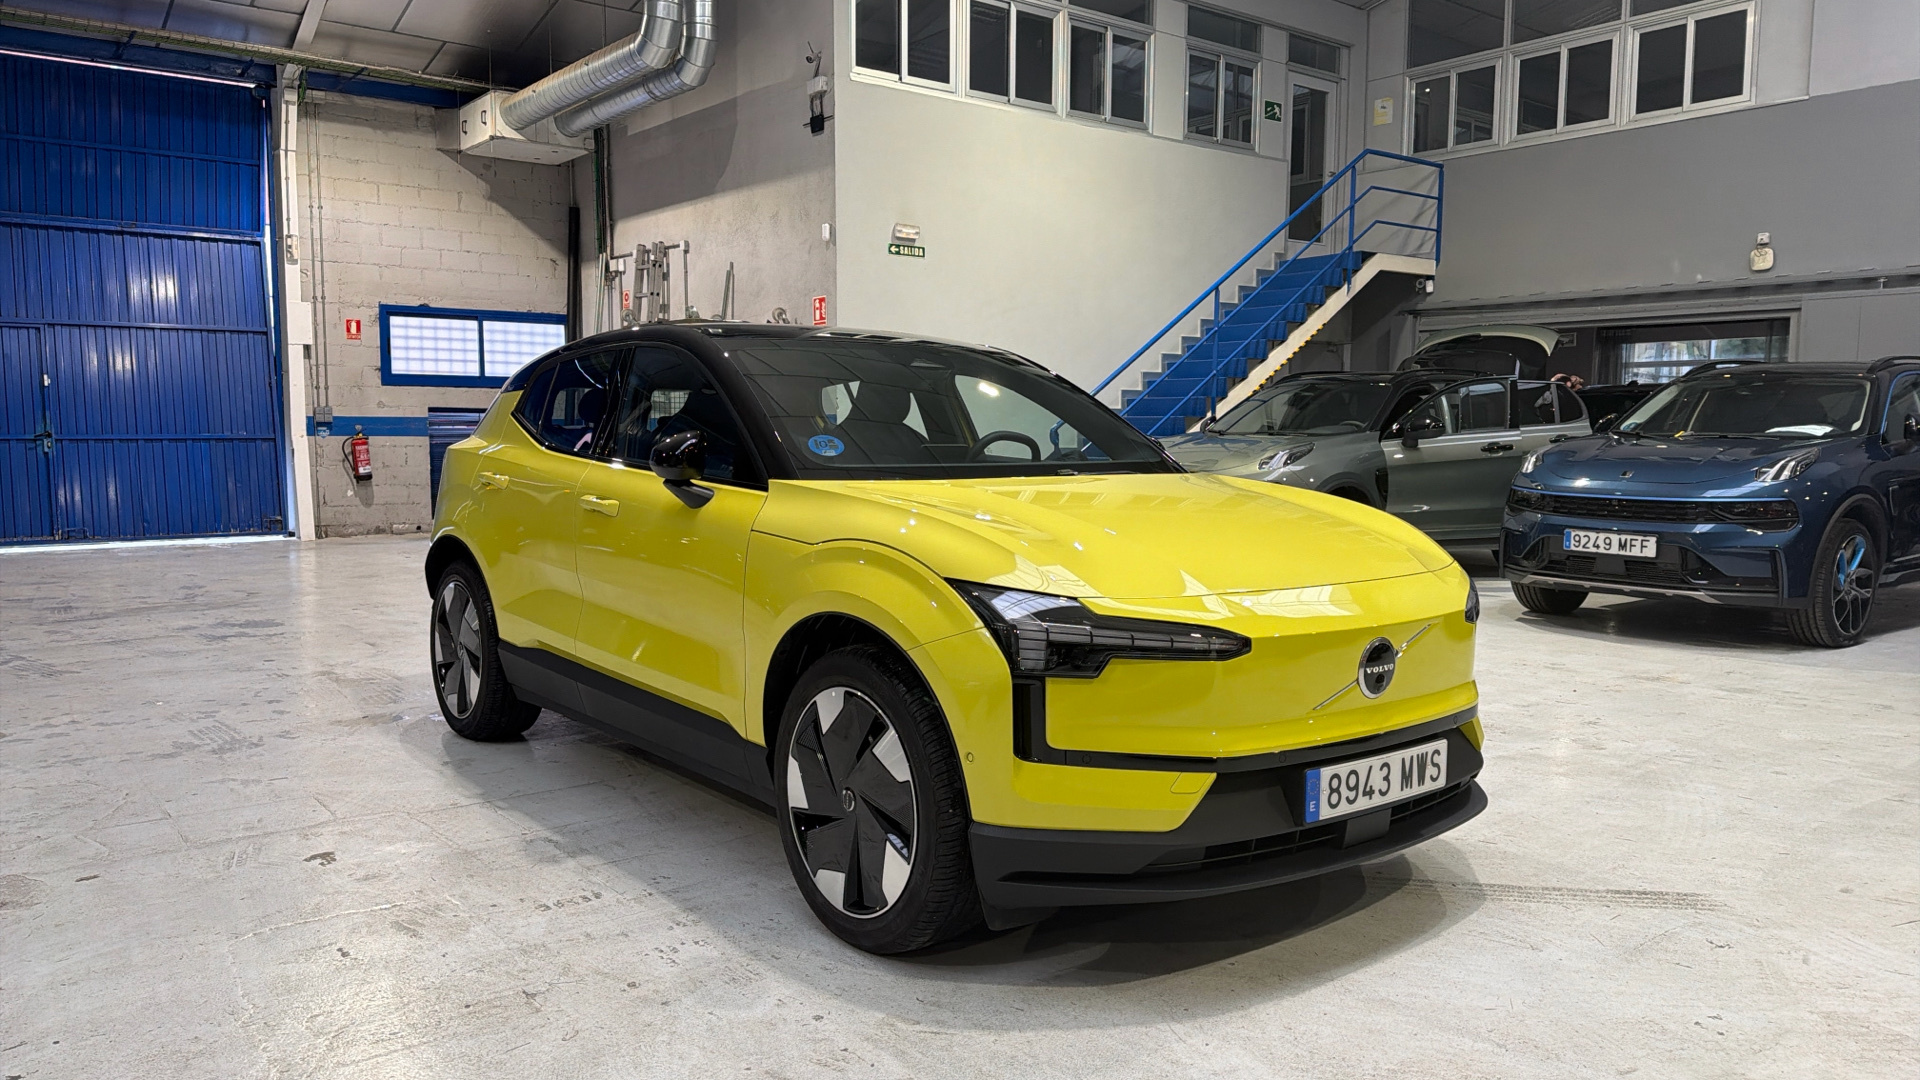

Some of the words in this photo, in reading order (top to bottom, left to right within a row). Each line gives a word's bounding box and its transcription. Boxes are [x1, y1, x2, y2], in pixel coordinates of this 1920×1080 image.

[899, 245, 924, 257] SALIDA
[1573, 533, 1613, 551] 9249
[1618, 537, 1650, 554] MFF
[1365, 663, 1394, 674] VOLVO
[1327, 762, 1391, 810] 8943
[1400, 749, 1442, 792] MWS
[1309, 801, 1316, 812] E
